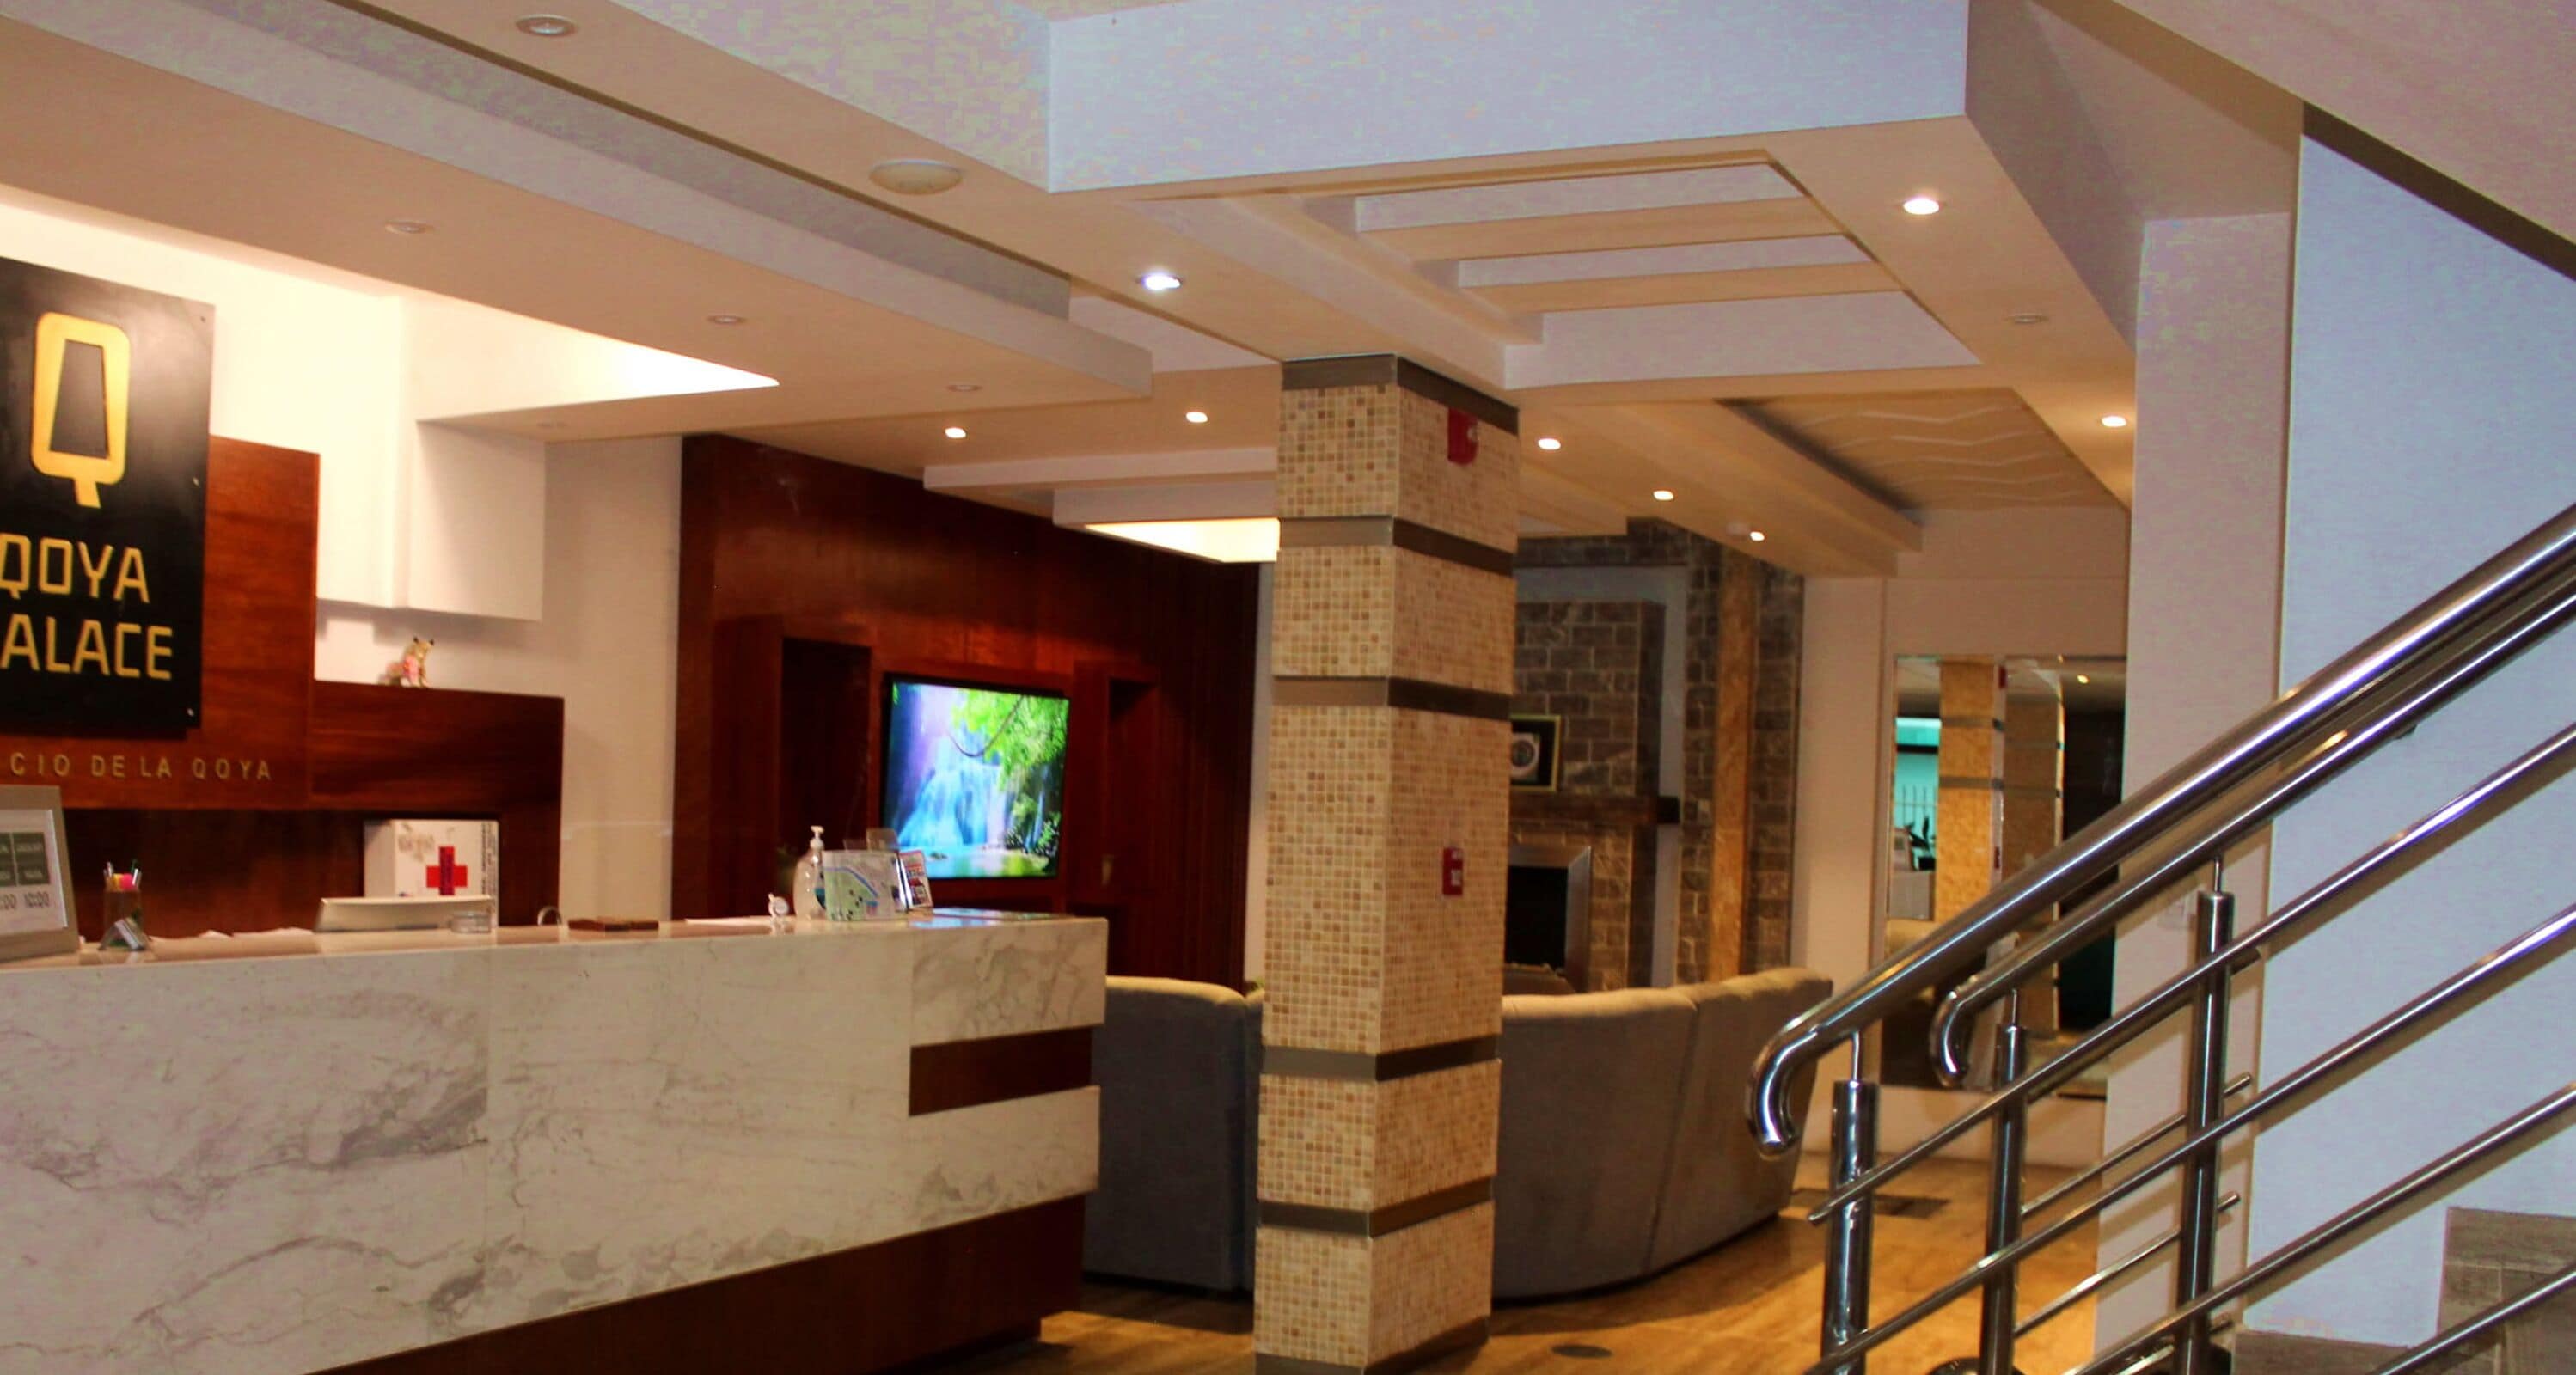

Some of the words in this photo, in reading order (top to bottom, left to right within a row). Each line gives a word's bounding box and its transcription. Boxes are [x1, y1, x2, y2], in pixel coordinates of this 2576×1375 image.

[31, 311, 131, 508] Q
[0, 533, 150, 603] QOYA
[0, 613, 173, 680] ALACE
[9, 752, 70, 775] CIO
[91, 755, 126, 778] DE
[140, 755, 172, 779] LA
[192, 757, 272, 781] QOYA
